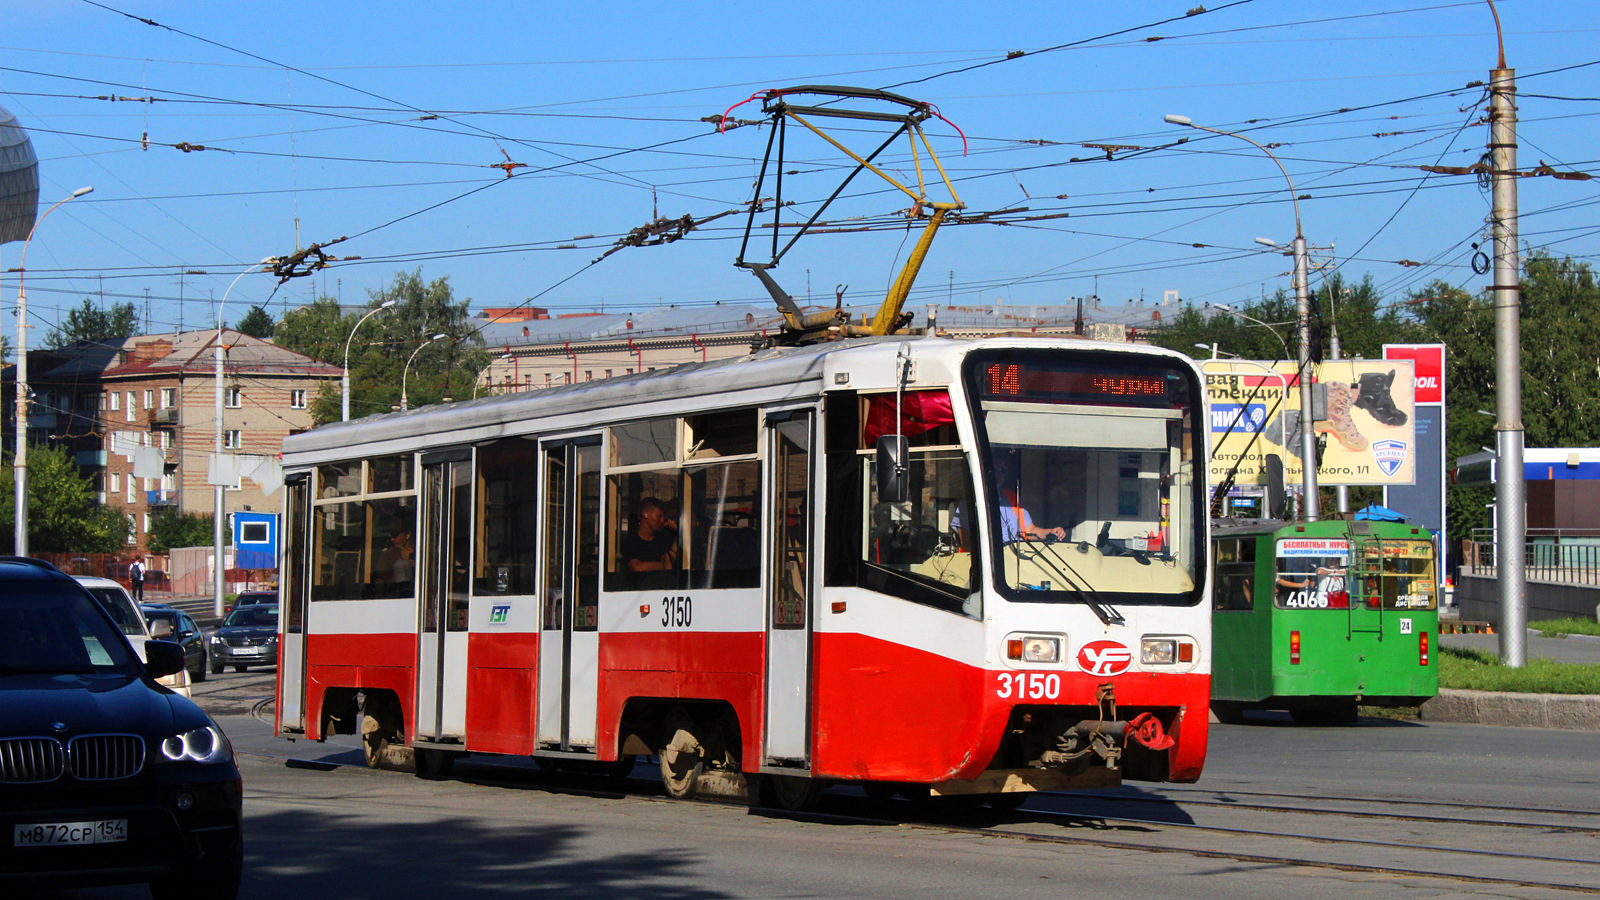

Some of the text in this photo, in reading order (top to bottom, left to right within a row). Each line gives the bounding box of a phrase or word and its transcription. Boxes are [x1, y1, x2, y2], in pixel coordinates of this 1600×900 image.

[988, 363, 1020, 395] 14
[1093, 378, 1164, 395] чури
[1357, 465, 1369, 475] 1/1
[1283, 541, 1326, 549] БЕСПЛАТНЫЕ
[662, 596, 692, 627] 3150
[1401, 621, 1410, 631] 24
[996, 673, 1061, 699] 3150
[19, 820, 124, 844] М872СР 154
